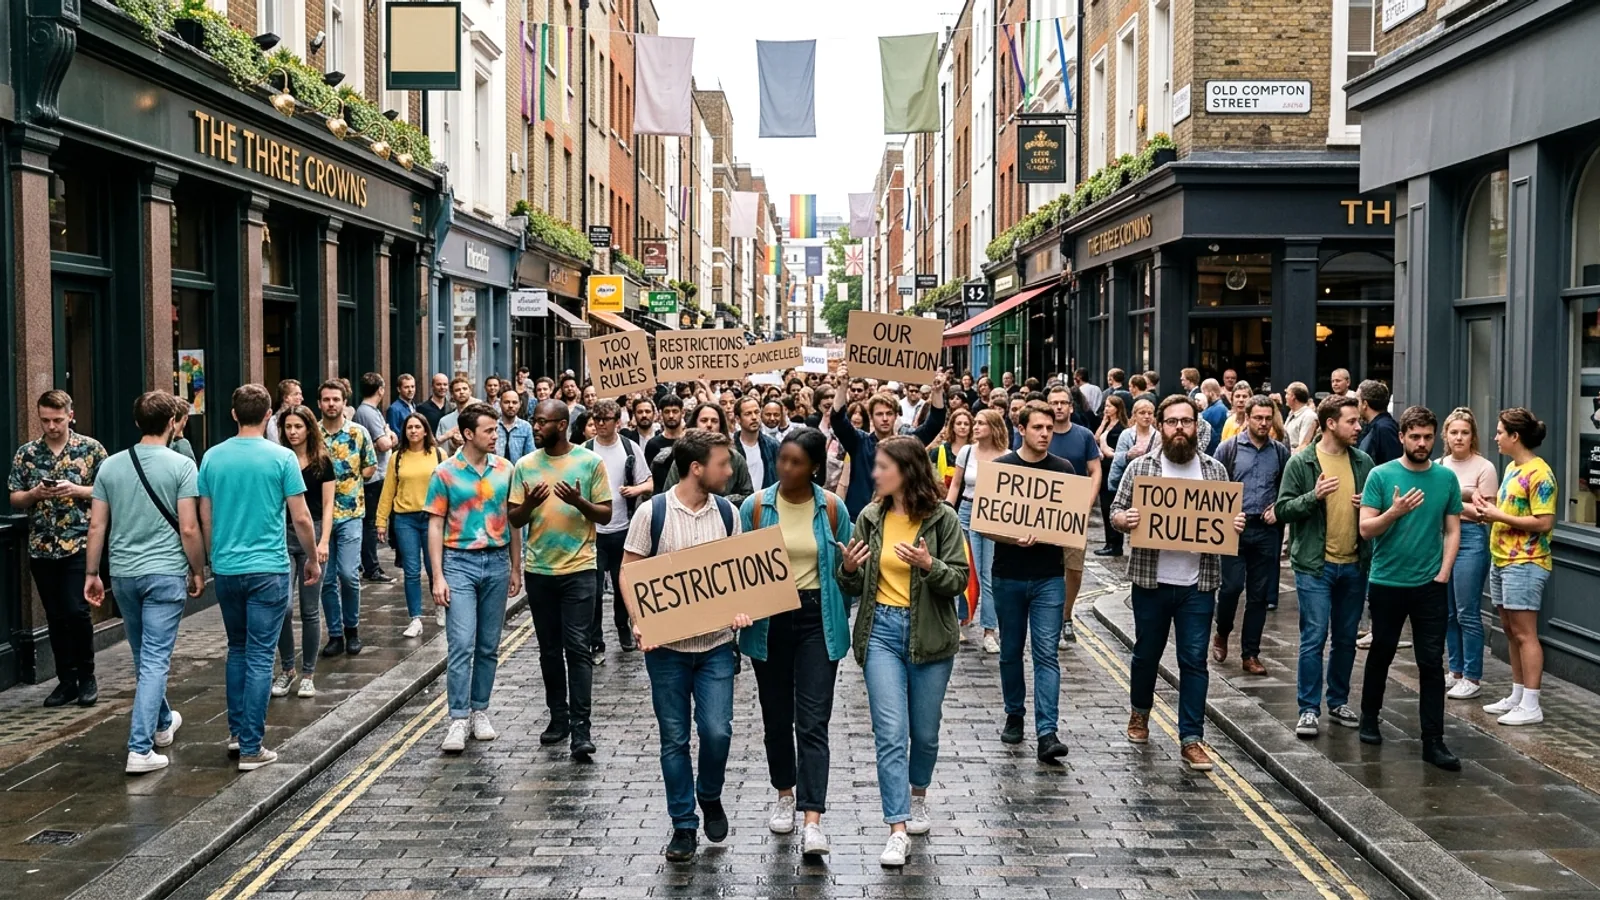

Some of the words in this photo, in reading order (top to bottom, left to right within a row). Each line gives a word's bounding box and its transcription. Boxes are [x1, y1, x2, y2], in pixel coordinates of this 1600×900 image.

[1212, 85, 1238, 96] OLD
[1241, 85, 1305, 96] COMPTON
[1212, 98, 1260, 108] STREET
[195, 110, 238, 164] THE
[243, 129, 300, 186] THREE
[304, 155, 367, 208] CROWNS
[600, 336, 631, 354] TOO
[873, 322, 912, 345] OUR
[598, 351, 639, 372] MANY
[659, 355, 685, 371] OUR
[687, 354, 740, 369] STREETS
[848, 344, 939, 372] REGULATION
[600, 367, 647, 390] RULES
[996, 471, 1064, 504] PRIDE
[1138, 484, 1178, 509] TOO
[1183, 488, 1239, 514] MANY
[976, 496, 1086, 536] REGULATION
[1148, 513, 1225, 546] RULES
[633, 547, 789, 619] RESTRICTIONS
